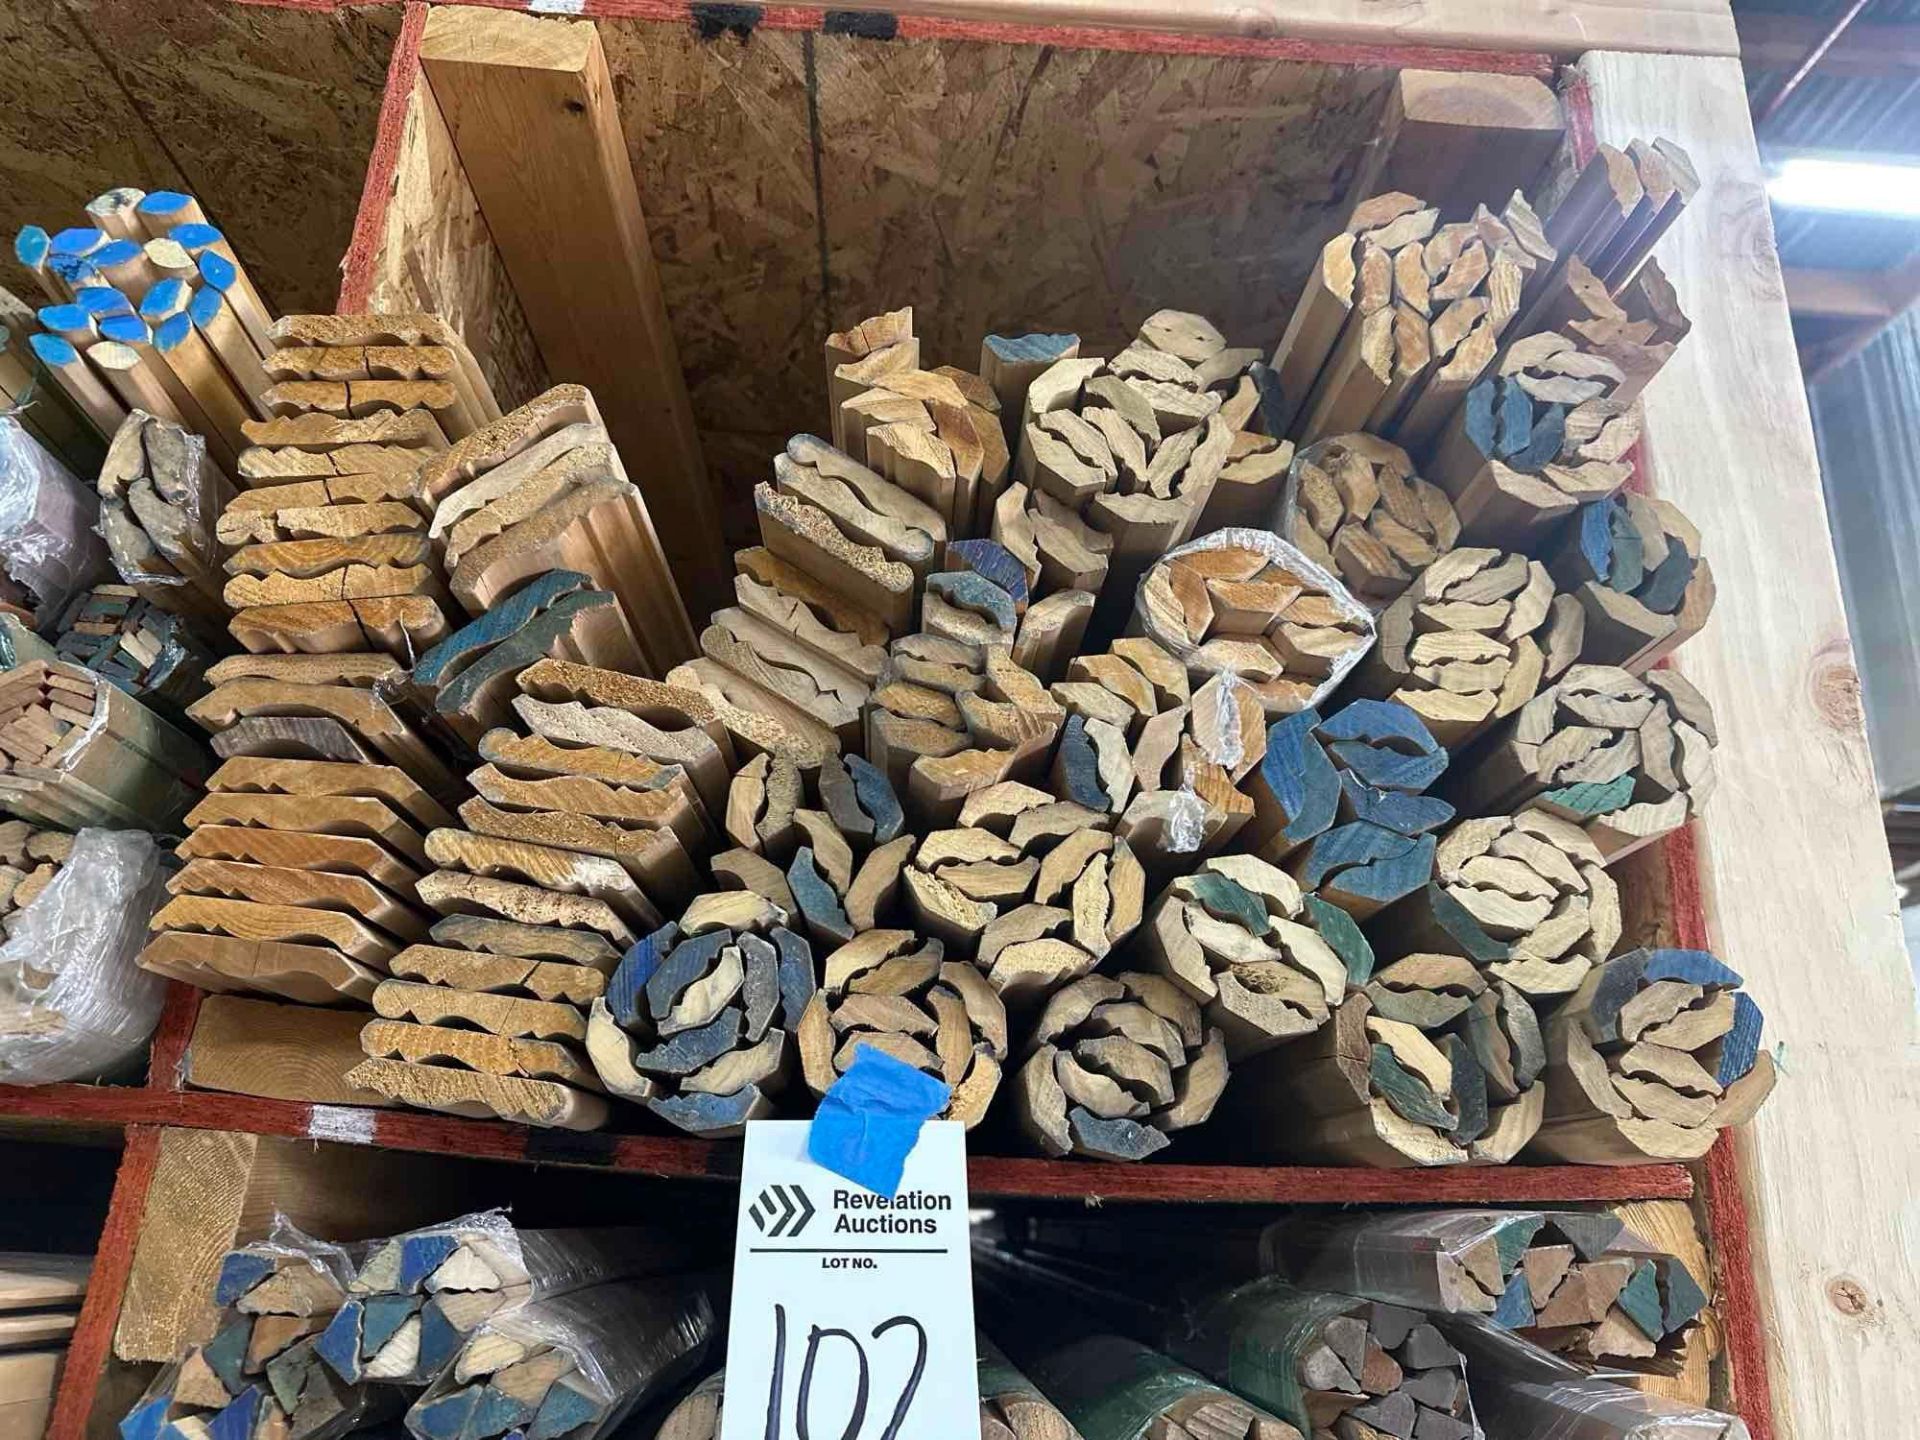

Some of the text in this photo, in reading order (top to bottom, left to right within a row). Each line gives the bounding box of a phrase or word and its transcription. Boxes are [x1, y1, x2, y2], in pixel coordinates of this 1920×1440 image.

[833, 1213, 937, 1234] Auctions
[821, 1257, 878, 1269] LOT NO.
